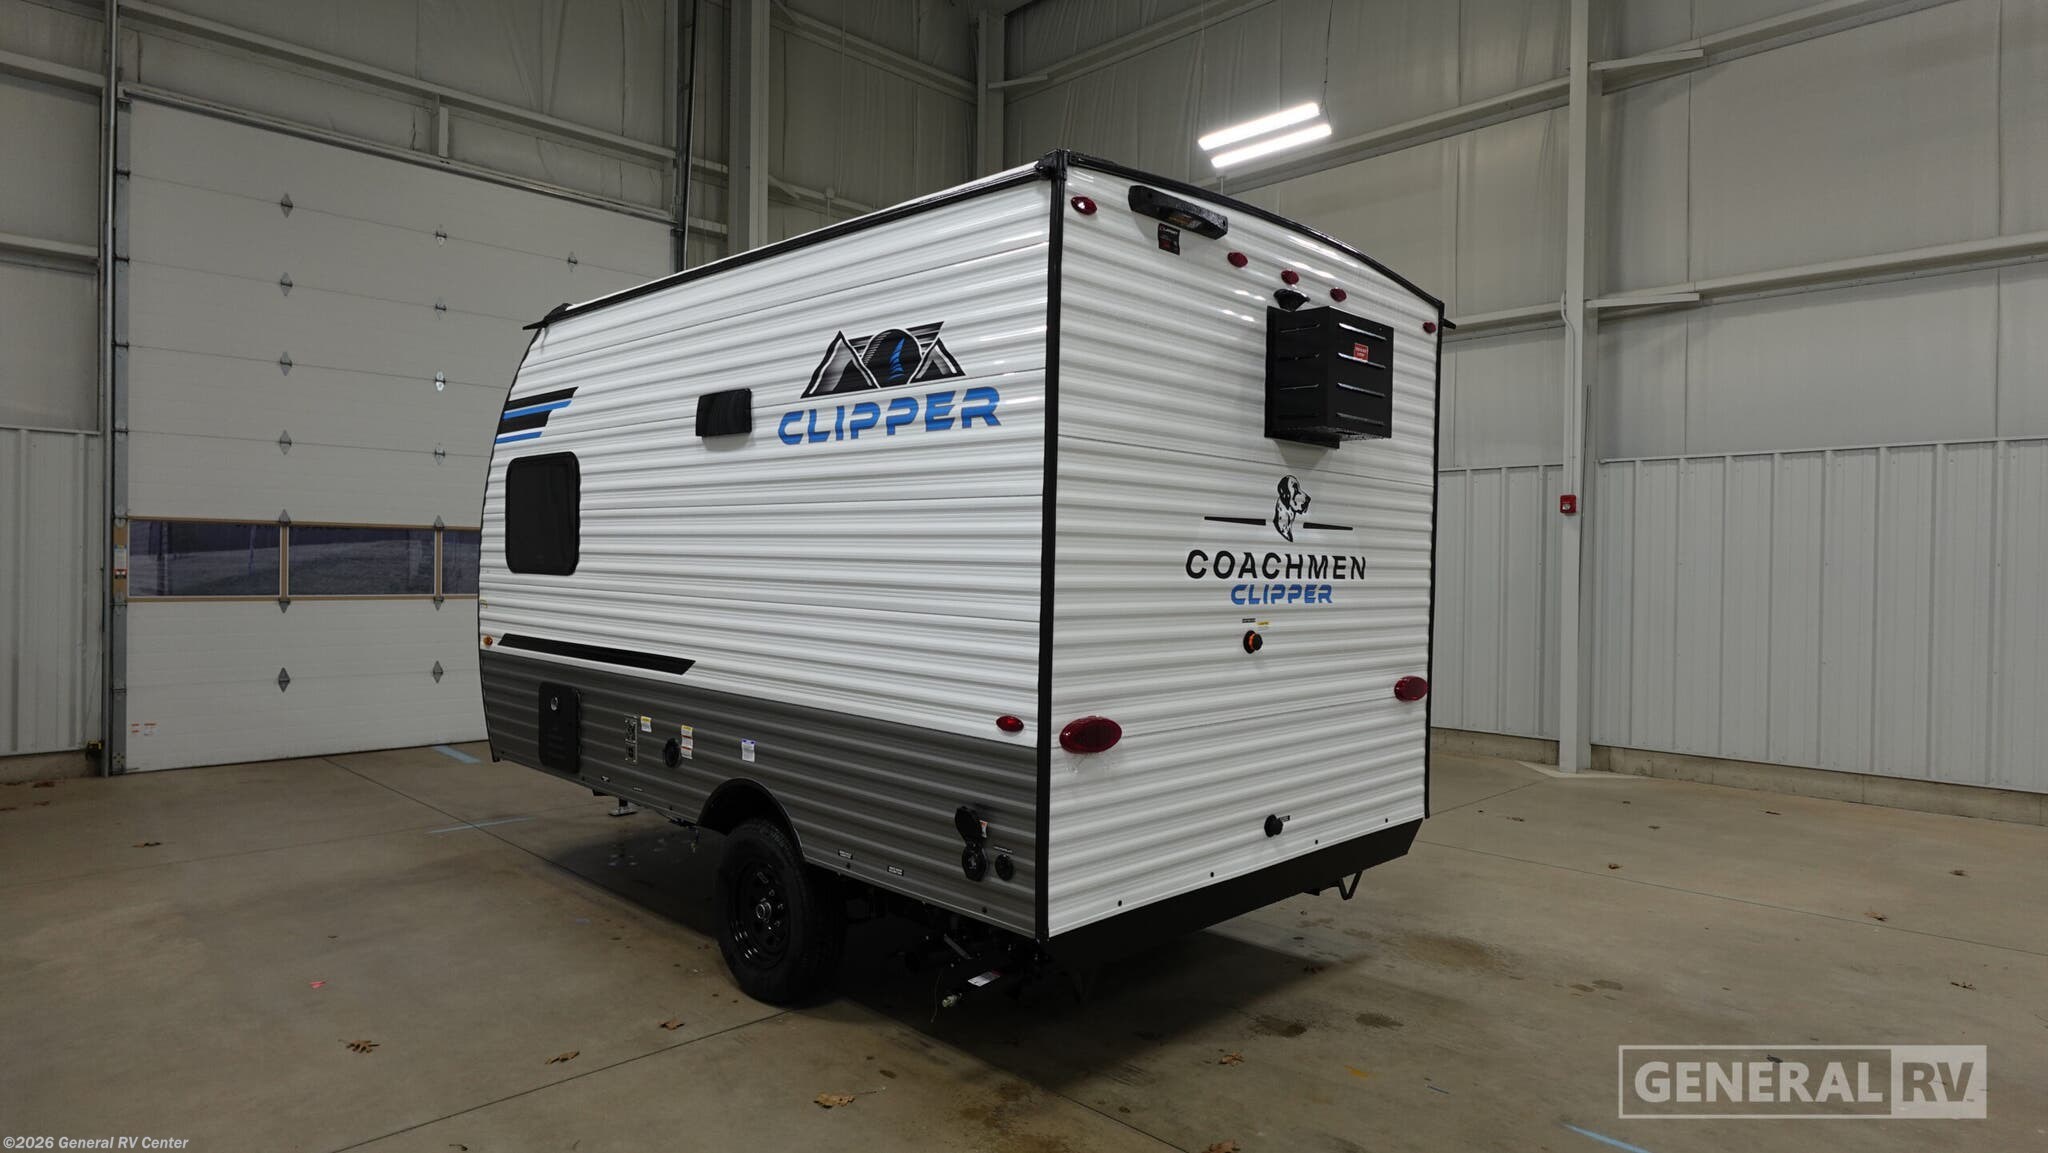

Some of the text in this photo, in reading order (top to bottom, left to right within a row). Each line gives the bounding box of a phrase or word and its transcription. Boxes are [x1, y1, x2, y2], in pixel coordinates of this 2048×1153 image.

[778, 386, 1001, 445] CLIPPER
[1186, 549, 1366, 580] COACHMEN
[1231, 584, 1333, 605] CLIPPER
